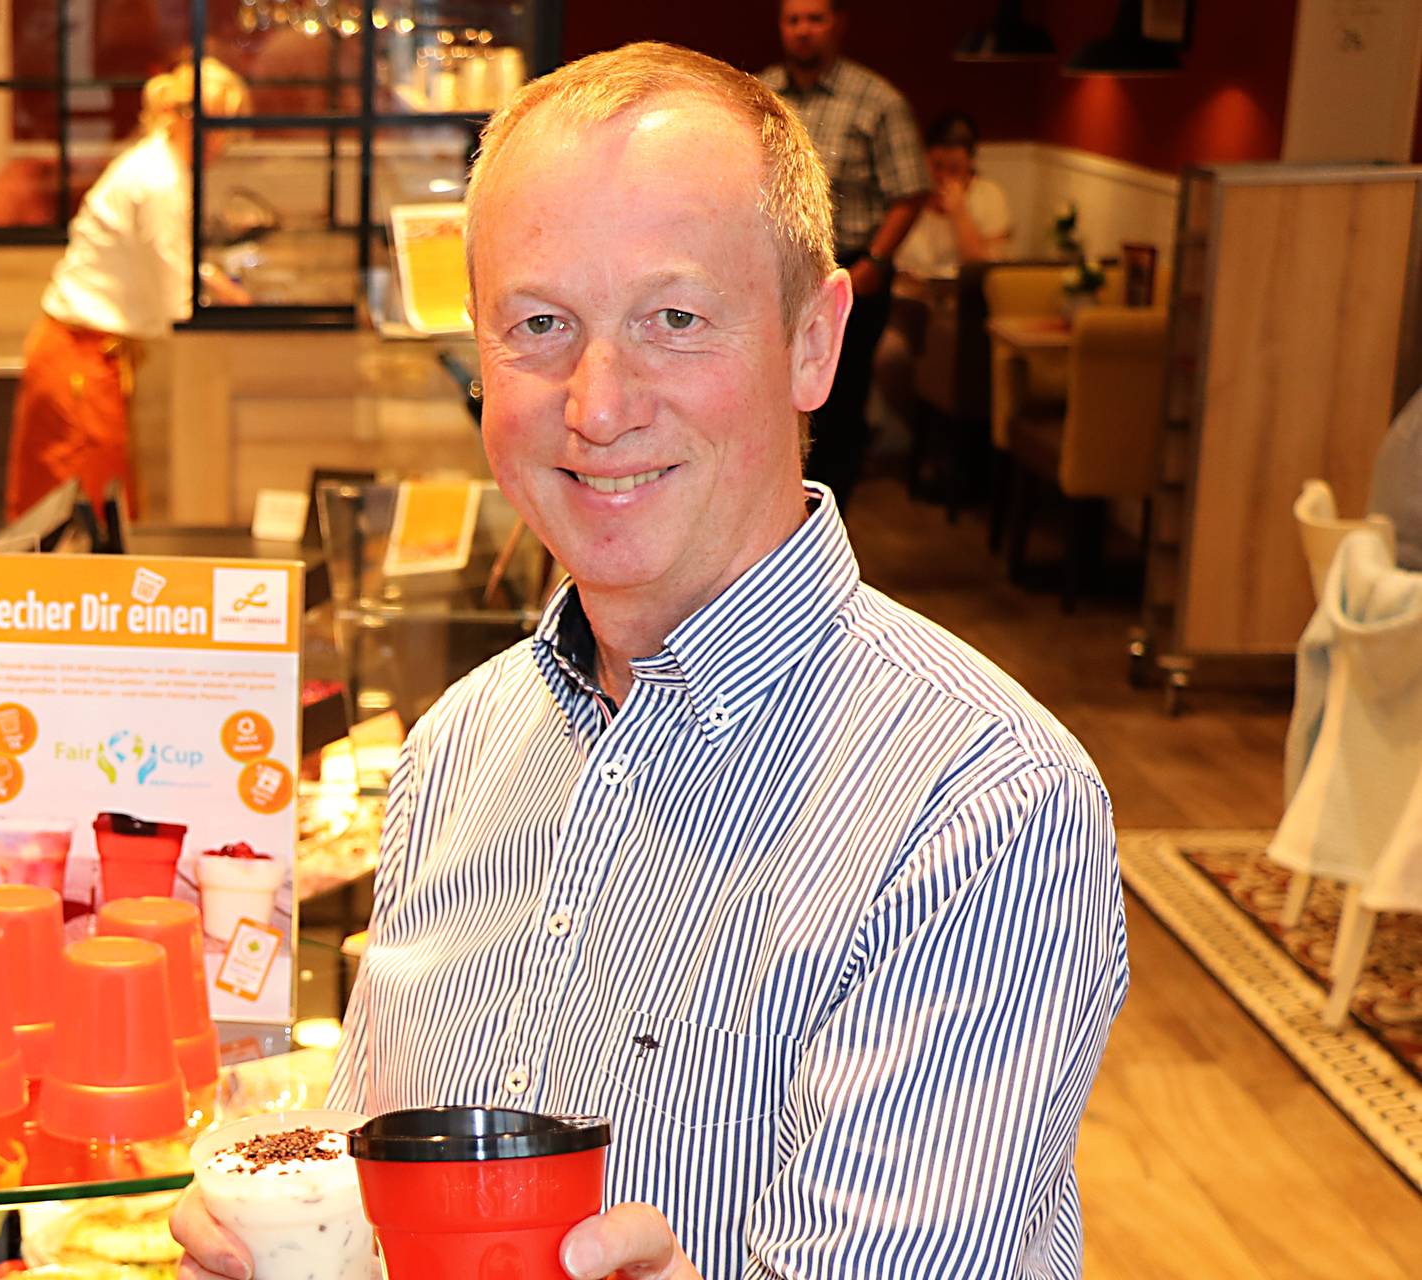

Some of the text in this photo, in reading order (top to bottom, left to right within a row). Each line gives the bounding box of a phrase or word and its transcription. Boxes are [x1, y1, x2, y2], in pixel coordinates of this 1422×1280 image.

[81, 592, 121, 633] Dir
[128, 602, 207, 635] einen
[54, 741, 204, 768] Fair Cup
